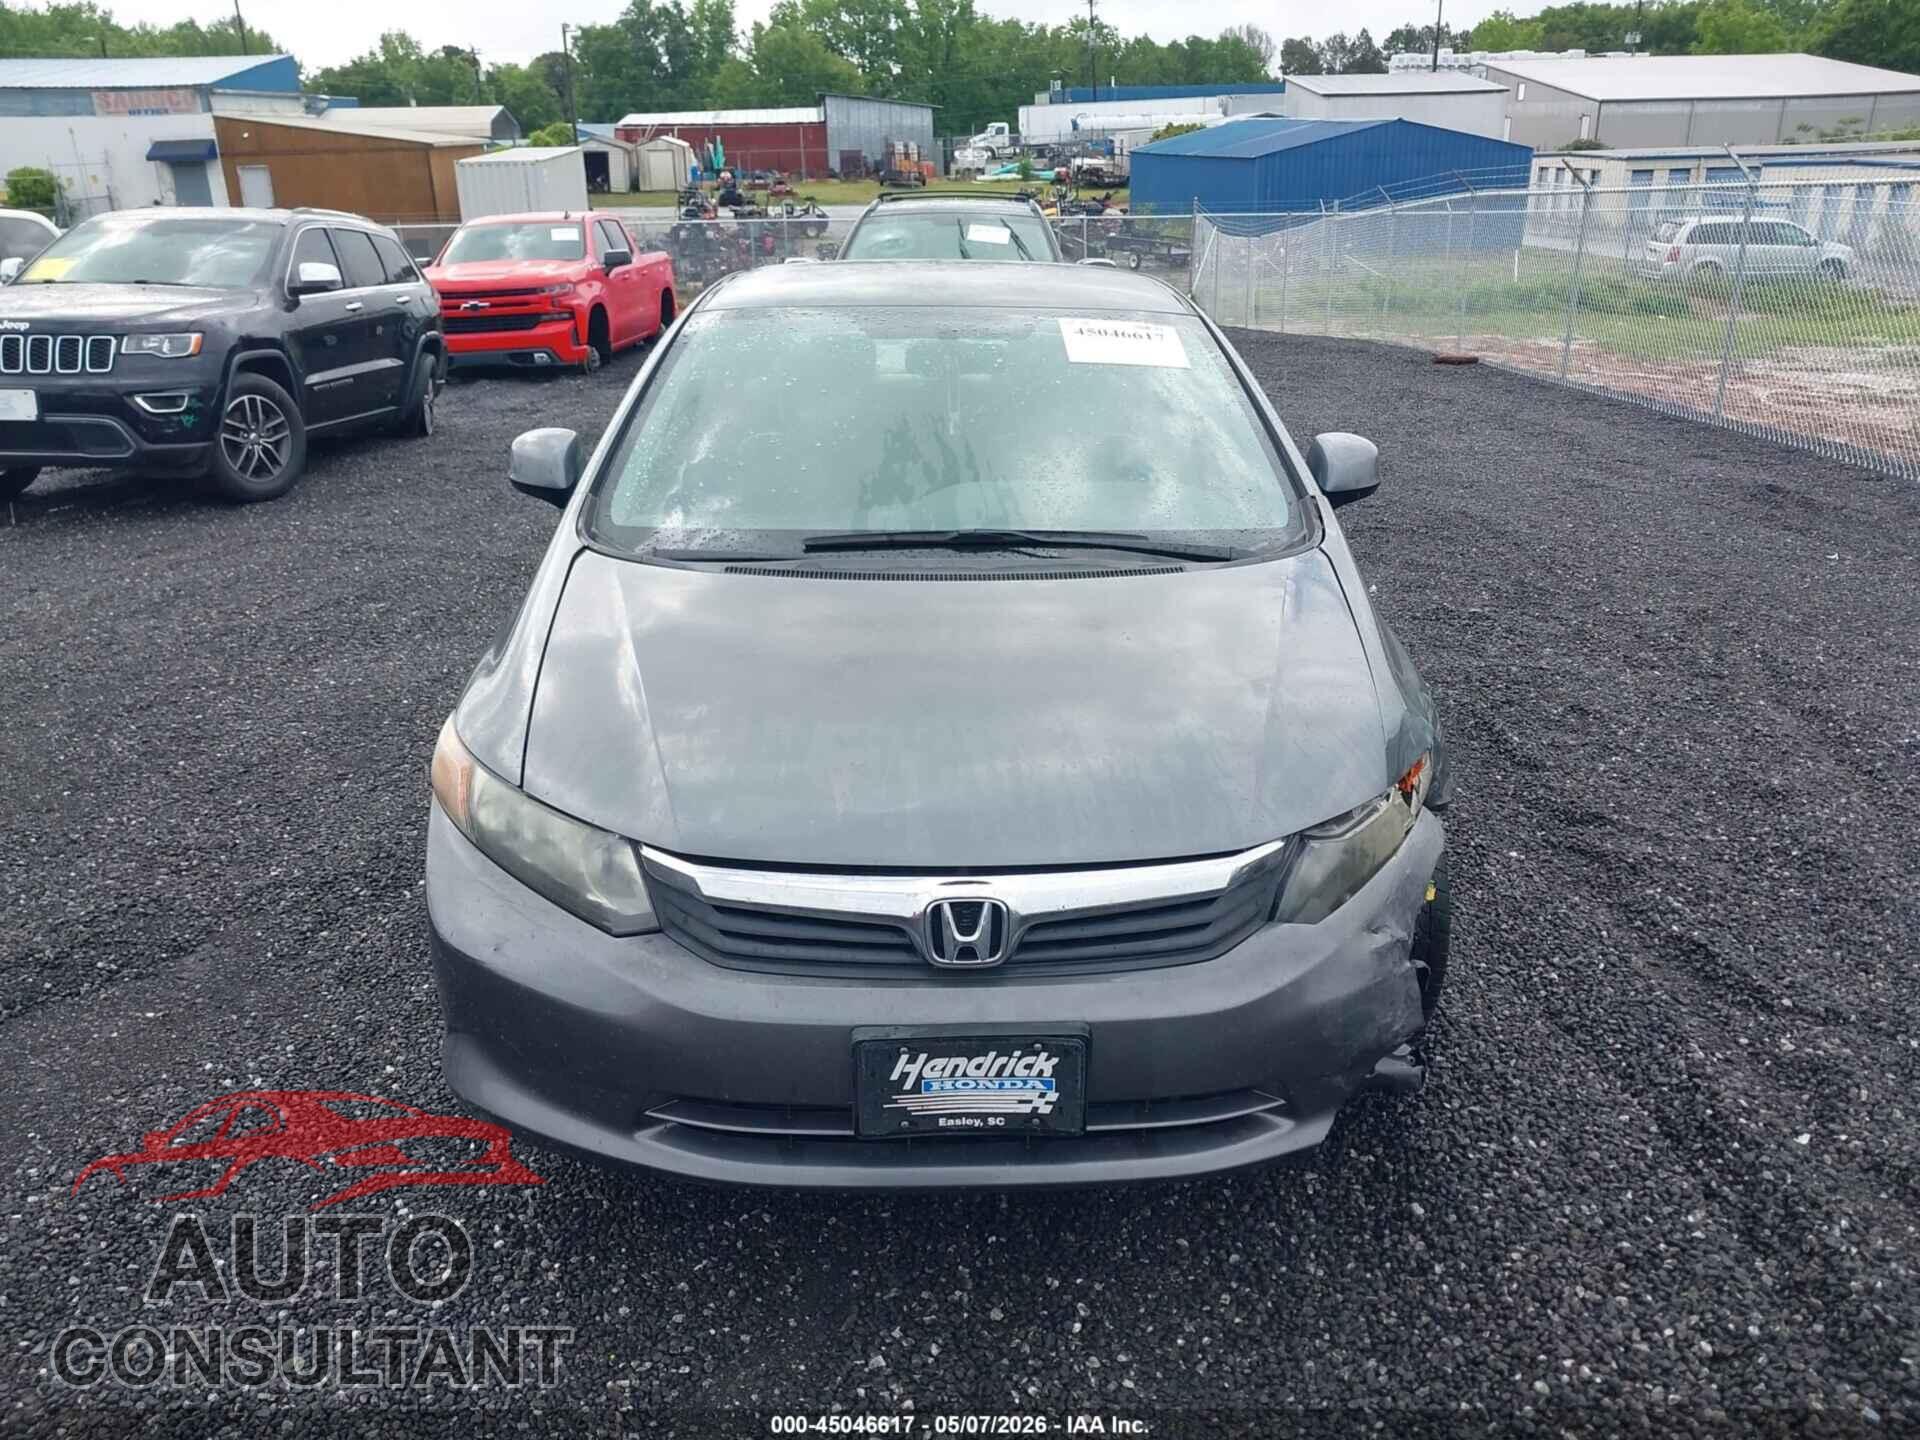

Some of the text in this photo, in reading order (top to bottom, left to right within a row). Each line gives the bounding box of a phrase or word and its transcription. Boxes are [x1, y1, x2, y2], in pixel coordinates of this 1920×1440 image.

[0, 319, 30, 331] Jeep
[889, 1051, 1060, 1090] Hendrick
[929, 1080, 1048, 1091] HONDA
[938, 1117, 1005, 1127] Easley, SC
